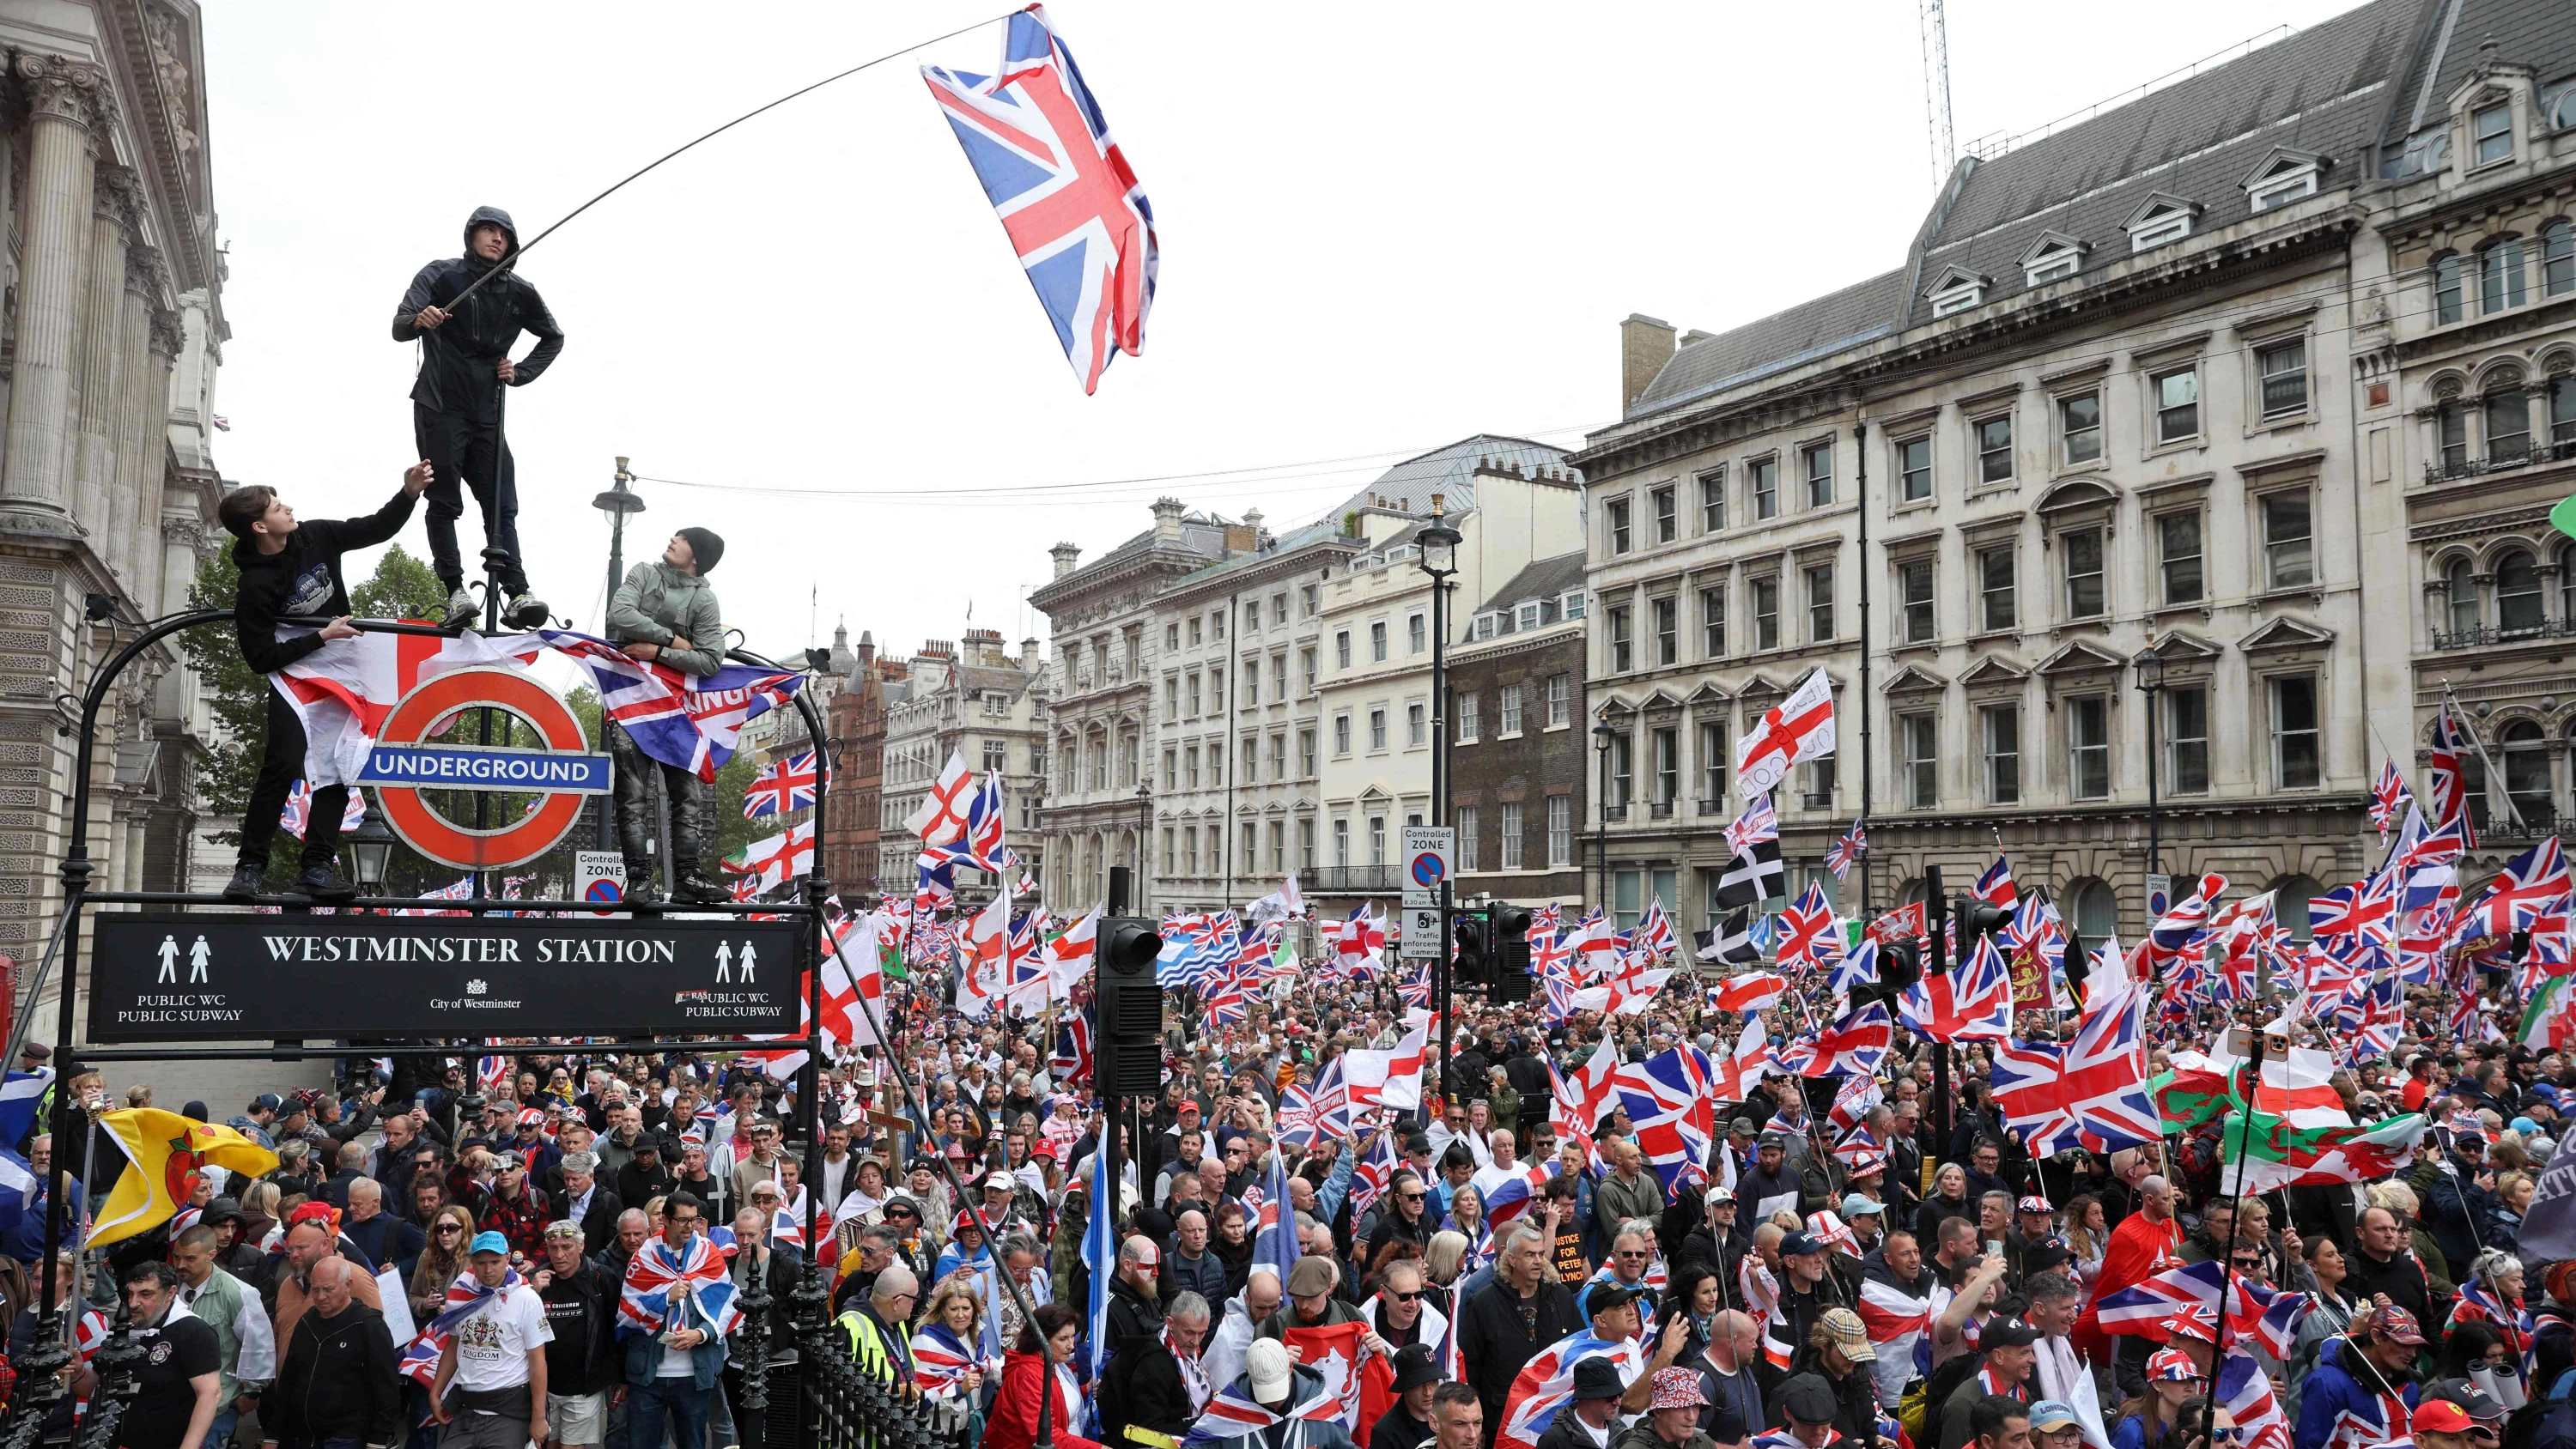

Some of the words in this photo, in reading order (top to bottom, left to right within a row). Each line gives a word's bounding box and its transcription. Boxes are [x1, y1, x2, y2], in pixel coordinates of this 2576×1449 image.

[375, 754, 590, 782] UNDERGROUND
[1406, 829, 1451, 838] Controlled
[1413, 840, 1444, 849] ZONE
[580, 854, 624, 864] Controlle
[586, 865, 623, 876] ZONE
[262, 936, 522, 962] WESTMINSTER
[536, 937, 677, 964] STATION
[137, 994, 197, 1007] PUBLIC
[198, 994, 226, 1007] WC
[430, 998, 448, 1010] City
[450, 997, 461, 1009] of
[464, 998, 521, 1009] Westminster
[748, 993, 769, 1003] WC
[117, 1009, 178, 1022] PUBLIC
[179, 1009, 243, 1022] SUBWAY
[686, 1007, 732, 1017] PUBLIC
[733, 1006, 782, 1017] SUBWAY
[877, 1115, 902, 1131] JESUS
[1560, 1247, 1577, 1258] FOR
[1558, 1258, 1583, 1270] PETER
[1560, 1270, 1584, 1282] LYNCH
[462, 1348, 500, 1359] KINGDOM
[2039, 1404, 2071, 1415] LONDON
